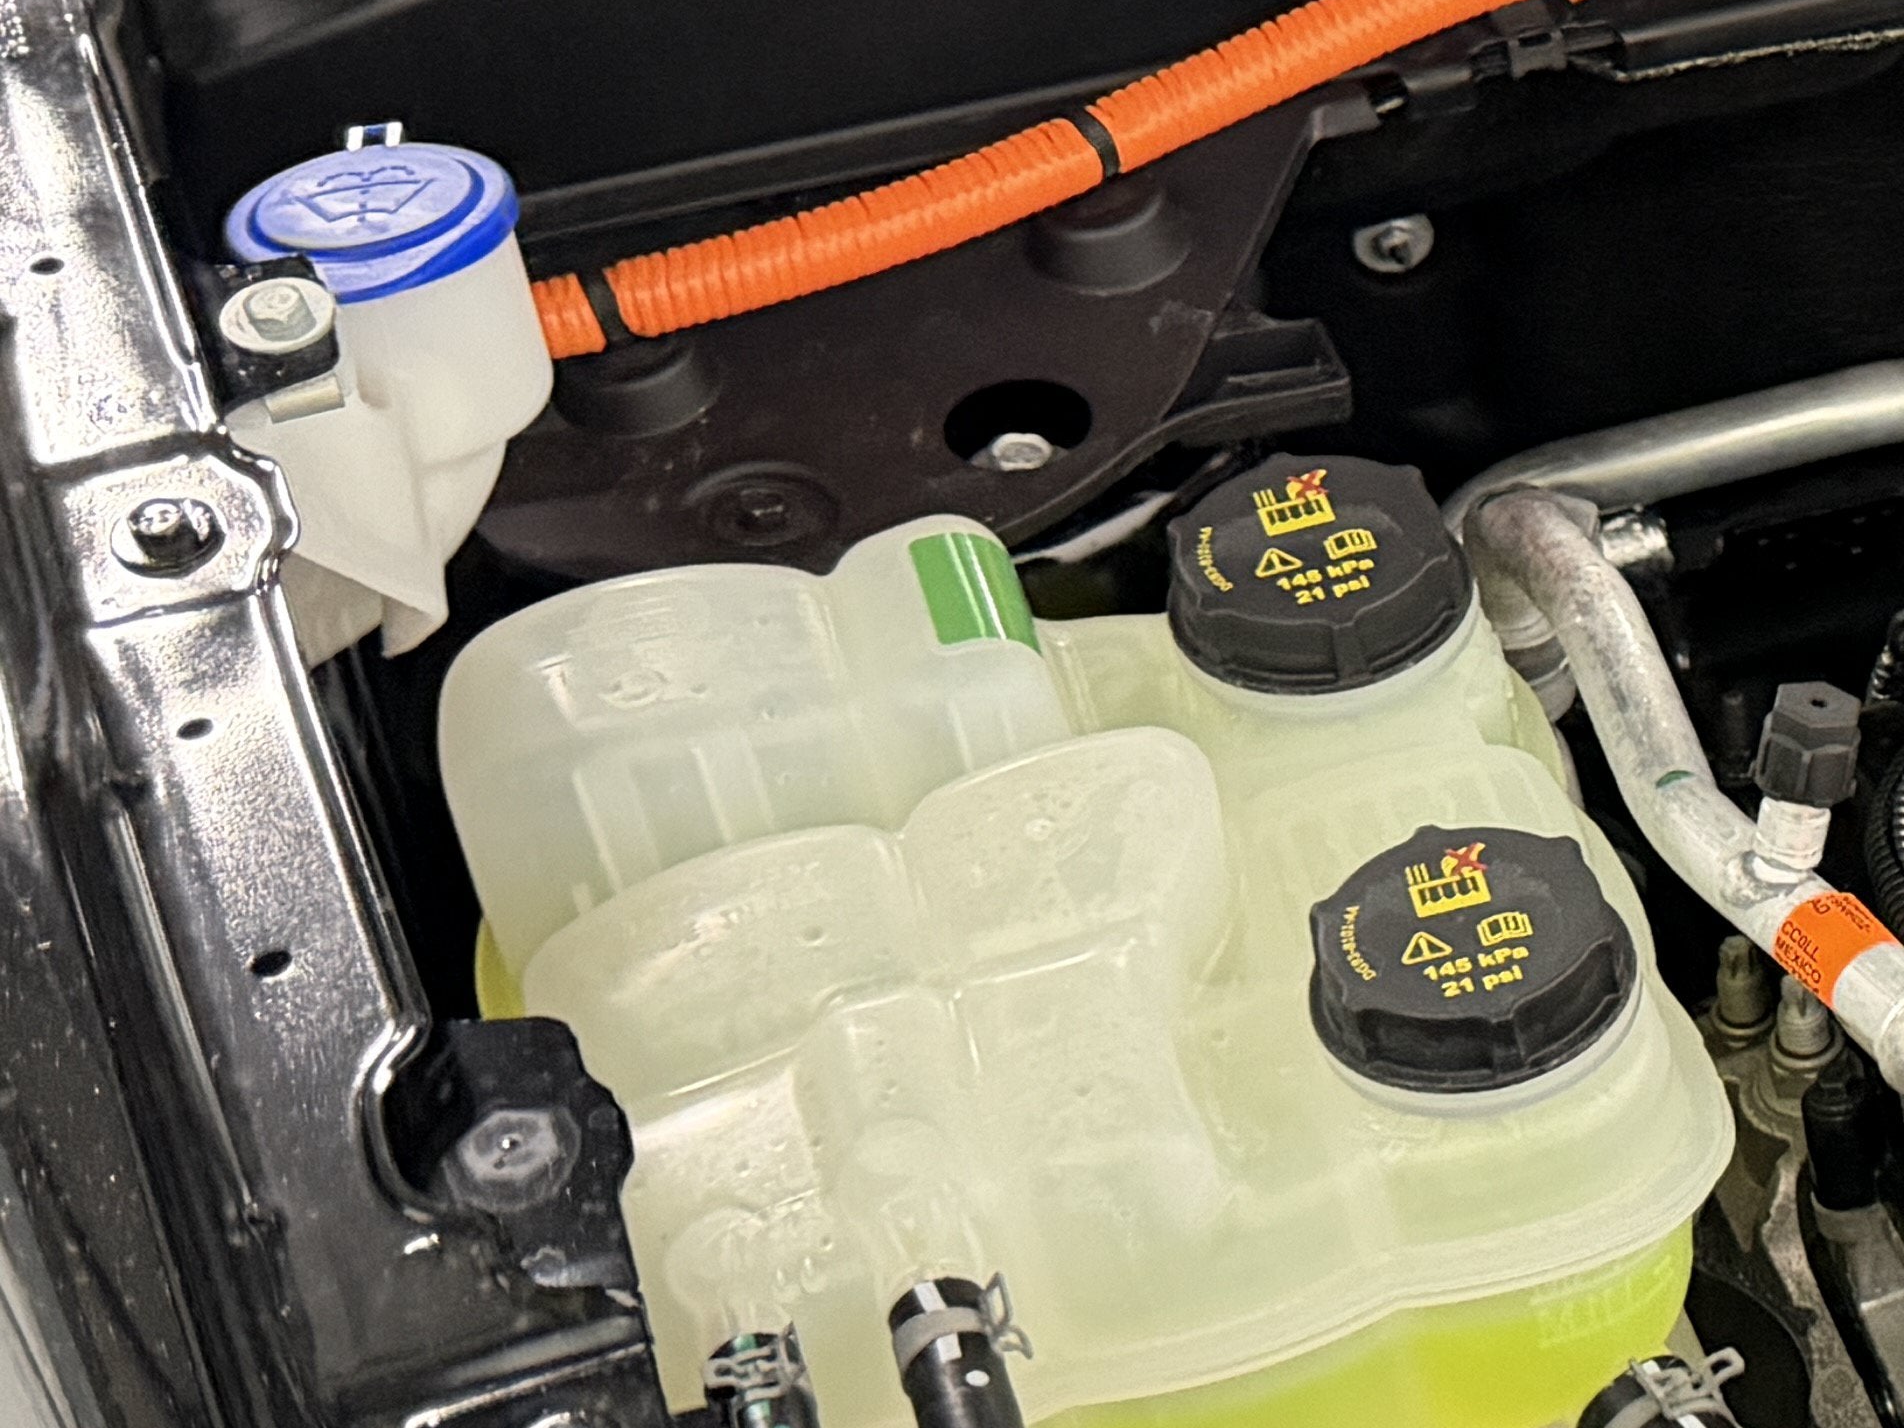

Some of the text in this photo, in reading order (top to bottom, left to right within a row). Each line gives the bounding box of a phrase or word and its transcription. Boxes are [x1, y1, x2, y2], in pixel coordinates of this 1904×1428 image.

[1277, 559, 1374, 590] 145 kPa
[1295, 575, 1370, 604] 21 psi
[1424, 947, 1529, 981] 145 kPa
[1441, 964, 1524, 997] 21 psi
